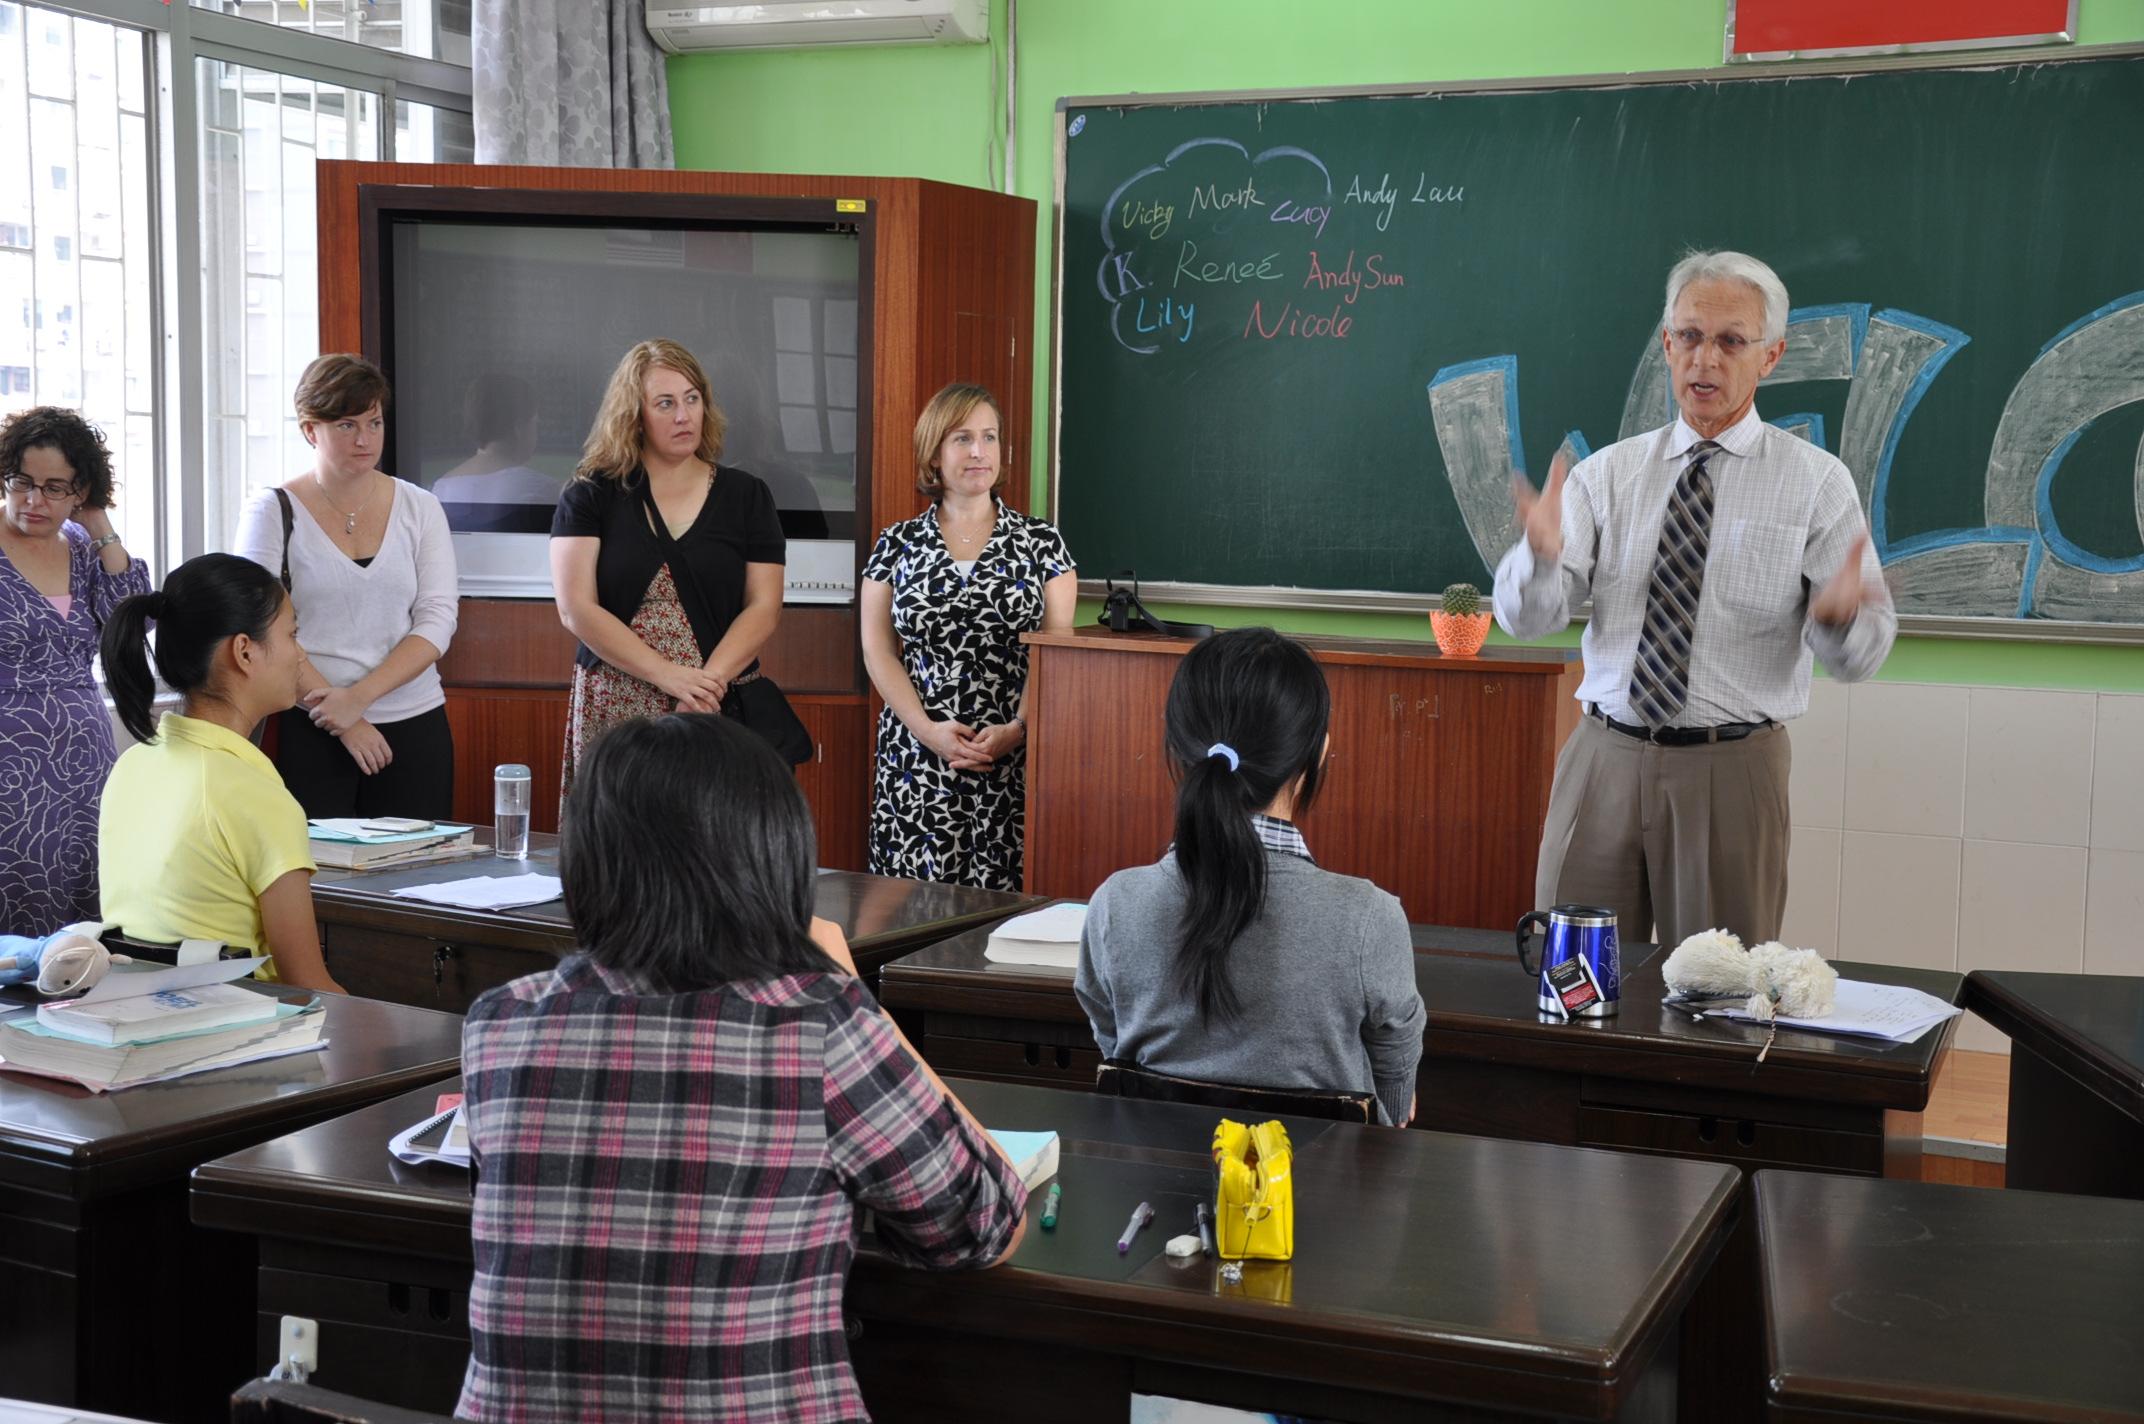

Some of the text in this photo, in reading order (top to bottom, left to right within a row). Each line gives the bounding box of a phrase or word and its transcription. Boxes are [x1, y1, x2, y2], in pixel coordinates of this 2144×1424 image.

[1187, 176, 1266, 219] Mark
[1270, 200, 1332, 239] Lucy
[1343, 173, 1398, 232] Andy
[1411, 172, 1464, 203] Lau
[1135, 297, 1353, 343] Lily Nicole
